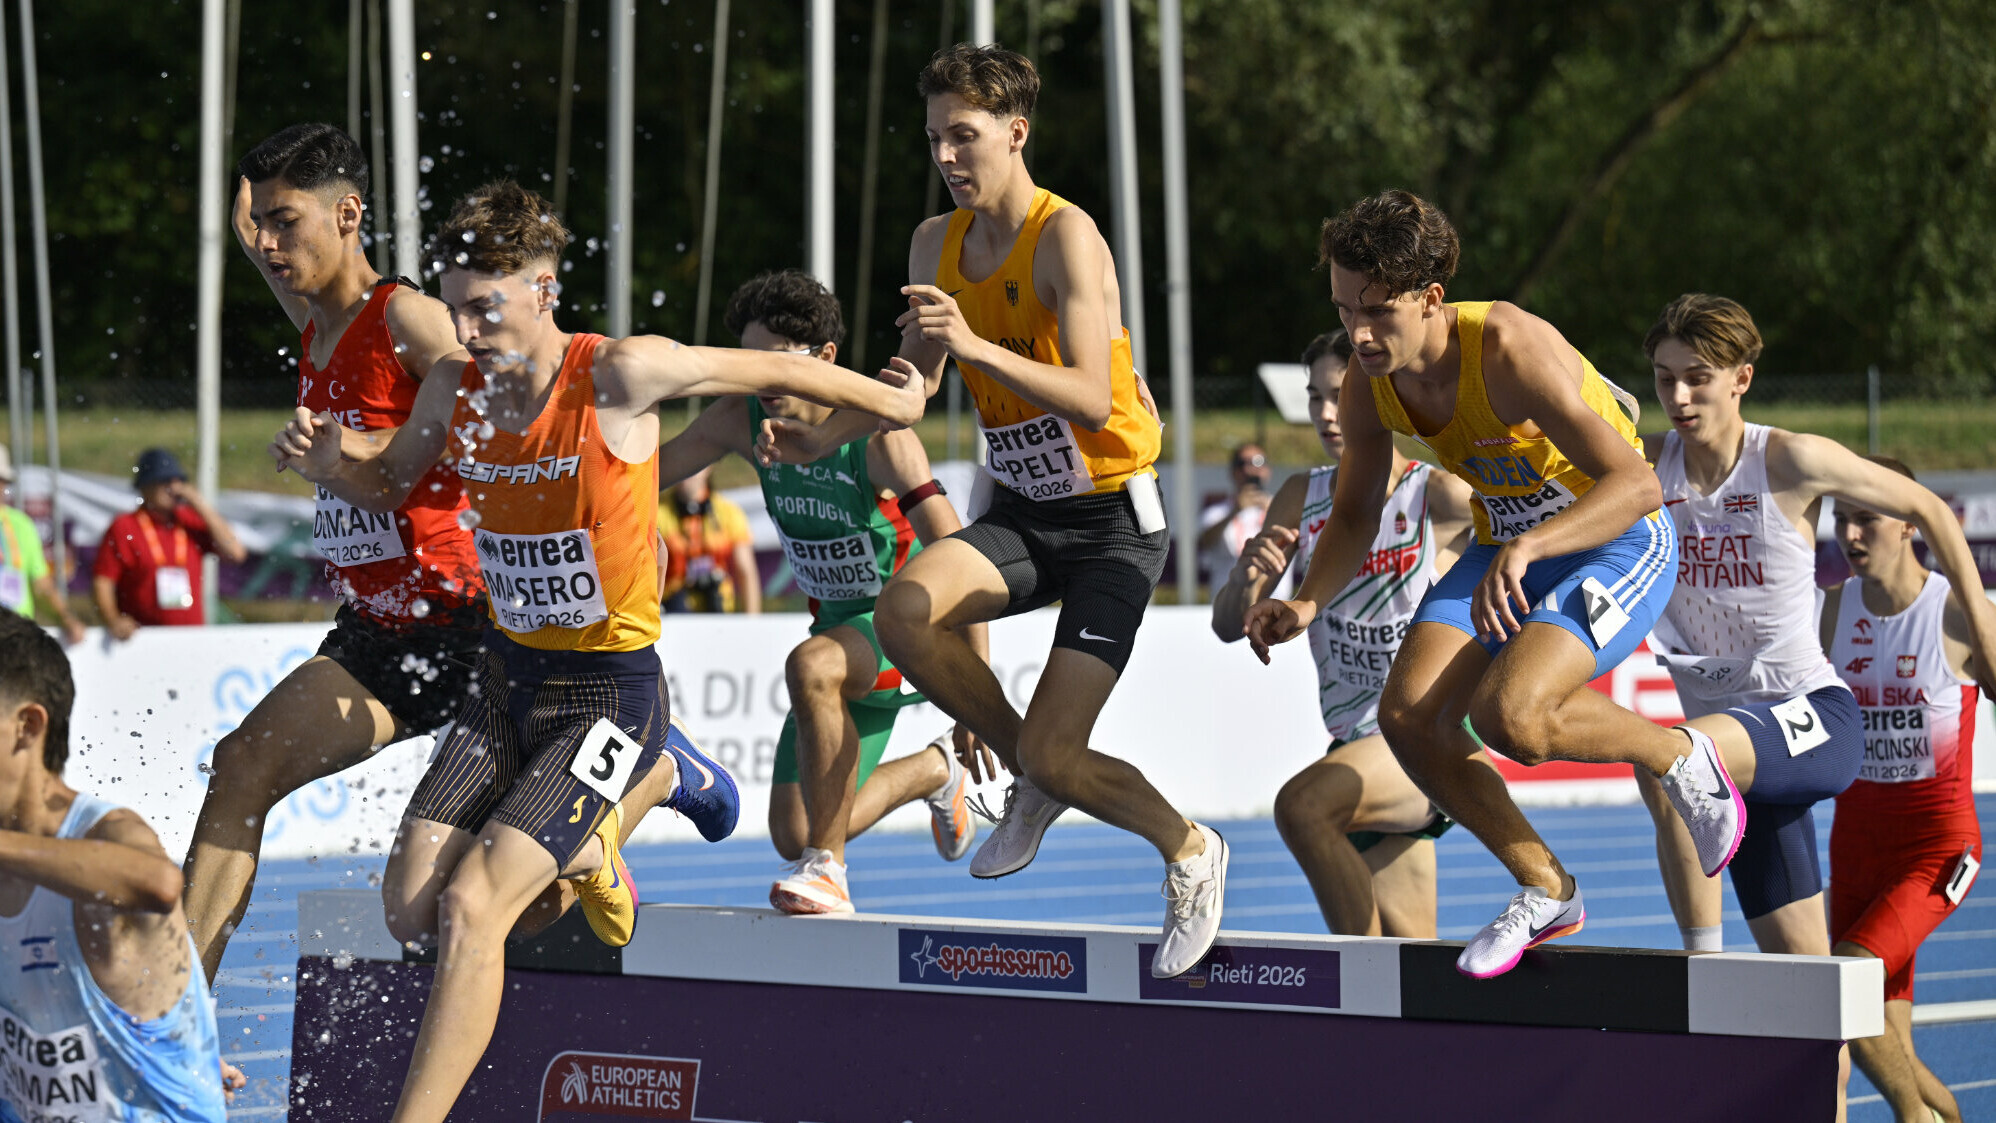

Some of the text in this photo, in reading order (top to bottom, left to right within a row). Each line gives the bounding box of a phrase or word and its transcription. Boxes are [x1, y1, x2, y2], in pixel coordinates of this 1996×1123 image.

[458, 455, 581, 485] ESPAÑA
[1031, 479, 1073, 498] 2026
[775, 495, 858, 528] PORTUGAL
[342, 541, 384, 562] 2026
[1677, 534, 1753, 562] REAT
[1677, 561, 1765, 589] RITAIN
[484, 569, 596, 608] MASERO
[501, 608, 585, 630] RIETI 2026
[1590, 595, 1611, 626] 1
[1852, 687, 1929, 708] OLSKA
[1785, 711, 1814, 740] 2
[589, 736, 624, 782] 5
[1863, 736, 1929, 761] HCINSKI
[1882, 763, 1918, 778] 2026
[937, 943, 1074, 981] sportissimo
[1210, 963, 1306, 987] Rieti 2026
[592, 1065, 681, 1089] EUROPEAN
[592, 1086, 681, 1110] ATHLETICS
